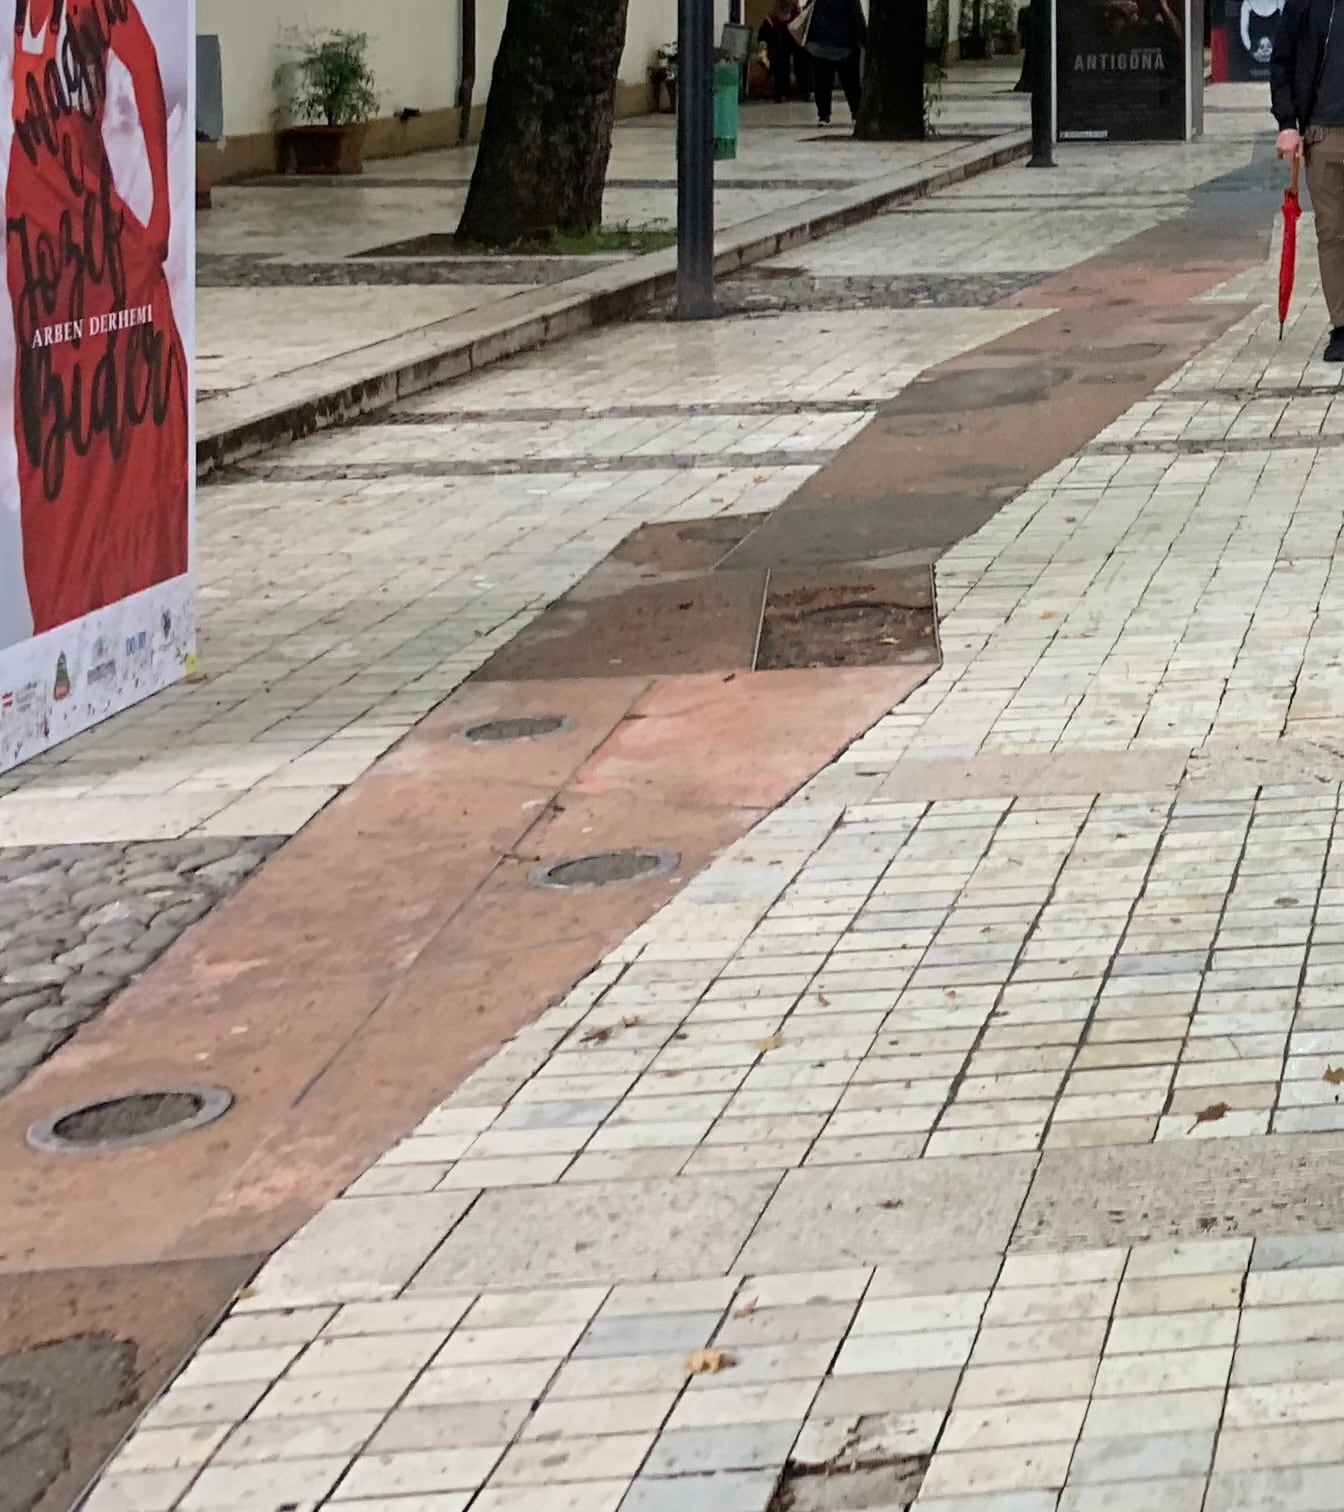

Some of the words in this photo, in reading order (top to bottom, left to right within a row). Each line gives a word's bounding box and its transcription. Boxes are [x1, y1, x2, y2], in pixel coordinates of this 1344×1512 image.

[1074, 52, 1165, 71] ANTIGONA
[31, 318, 84, 350] ARBEN
[89, 303, 154, 337] DERHEMI
